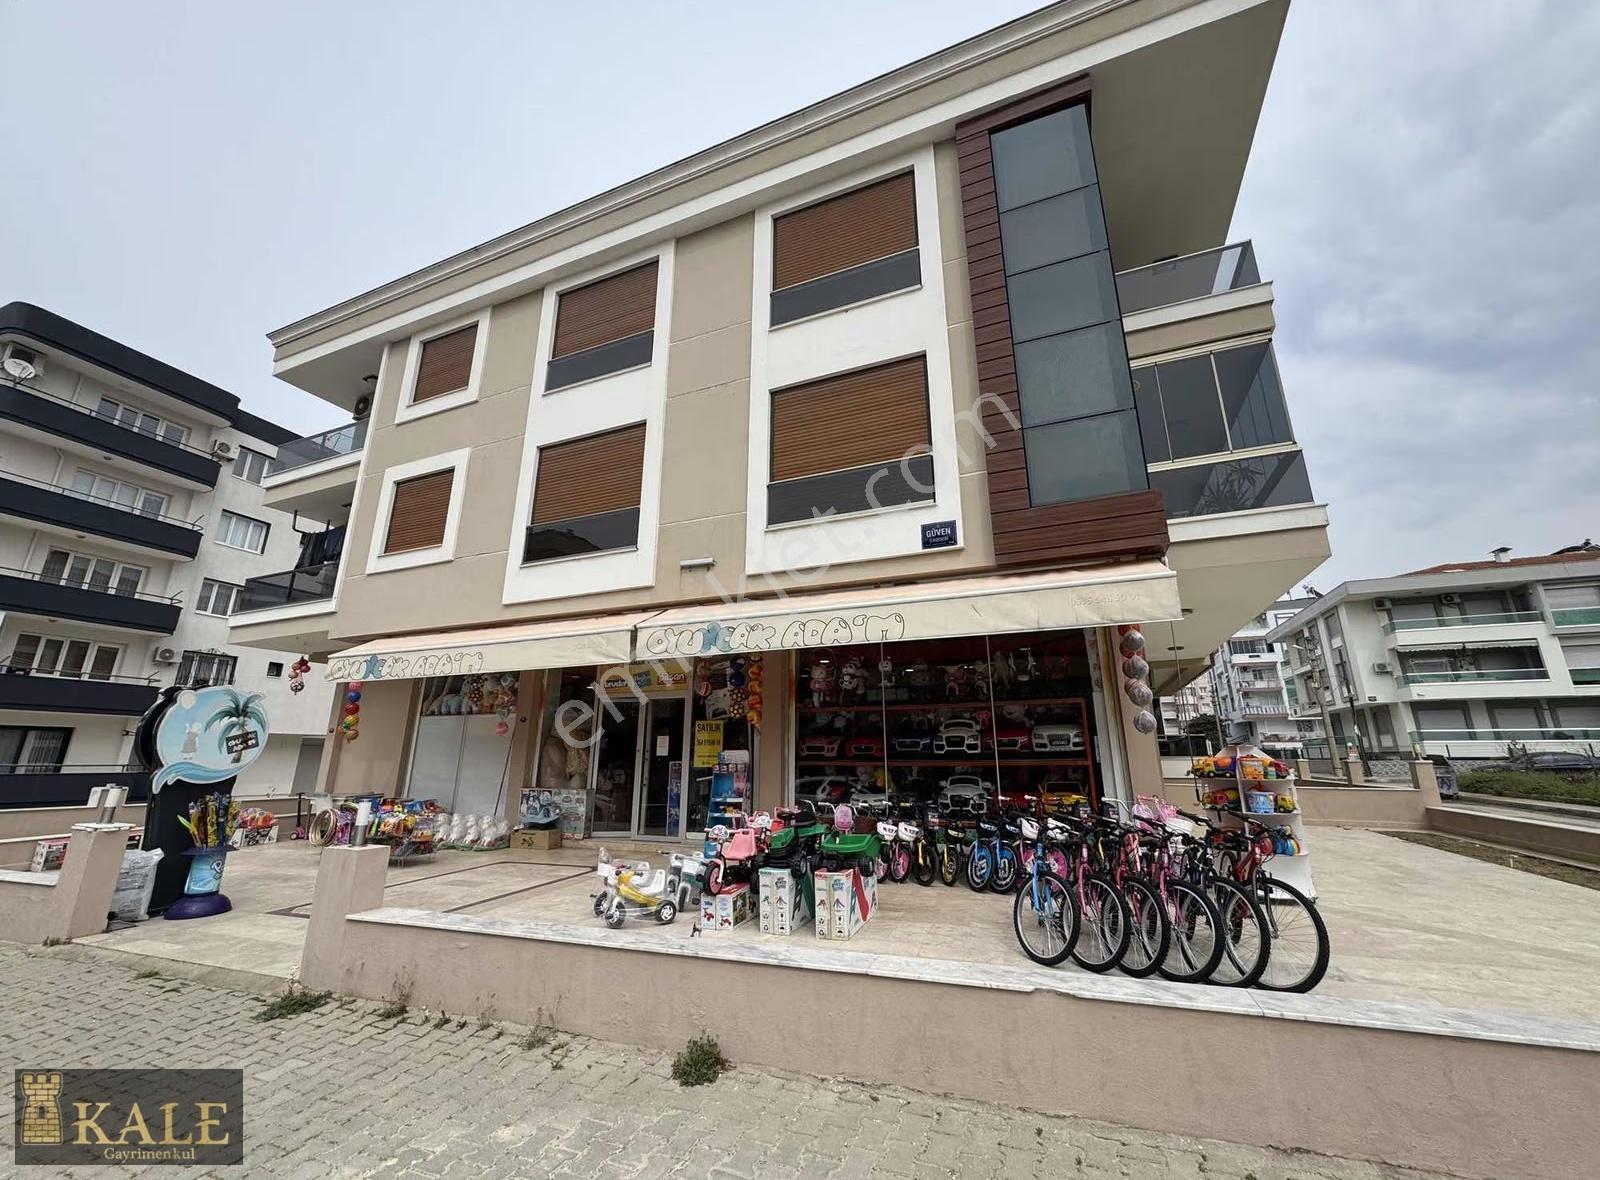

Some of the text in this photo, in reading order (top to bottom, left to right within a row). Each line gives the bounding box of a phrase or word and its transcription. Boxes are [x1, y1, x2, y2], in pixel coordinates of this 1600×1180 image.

[926, 527, 951, 538] GÜVEN
[647, 622, 776, 655] OYUNCAK
[330, 653, 410, 680] OYUNCAK
[697, 722, 721, 733] SATILIK
